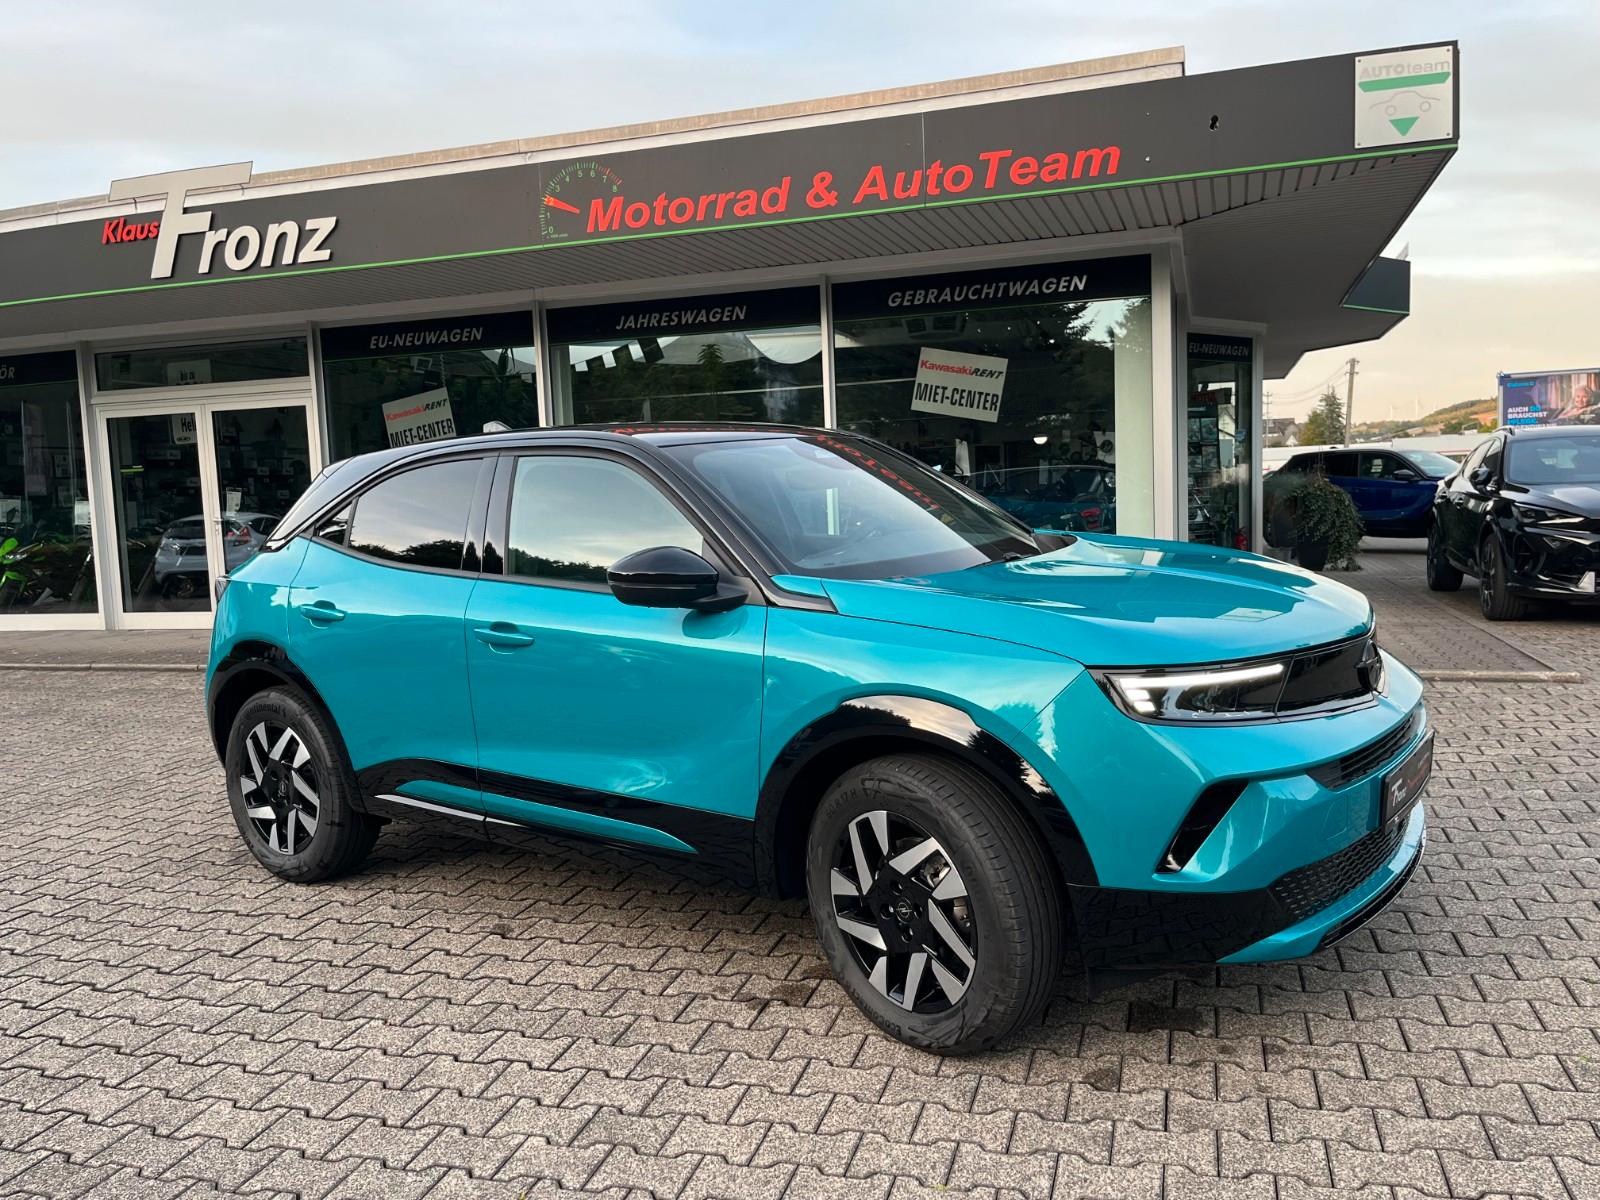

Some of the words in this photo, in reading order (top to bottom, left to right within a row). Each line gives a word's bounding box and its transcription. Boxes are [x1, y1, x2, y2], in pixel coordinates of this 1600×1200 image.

[1360, 61, 1450, 79] AUTOteam
[586, 176, 792, 233] Motorrad
[805, 171, 839, 208] &
[852, 145, 1121, 204] AutoTeam
[102, 216, 161, 245] Klaus
[107, 161, 338, 279] Fronz
[887, 275, 1087, 307] GEBRAUCHTWAGEN
[616, 305, 747, 330] JAHRESWAGEN
[369, 327, 483, 349] EU-NEUWAGEN
[1189, 342, 1249, 356] EU-NEUWAGEN
[914, 382, 1000, 412] MIET-CENTER
[390, 418, 454, 449] MIET-CENTER
